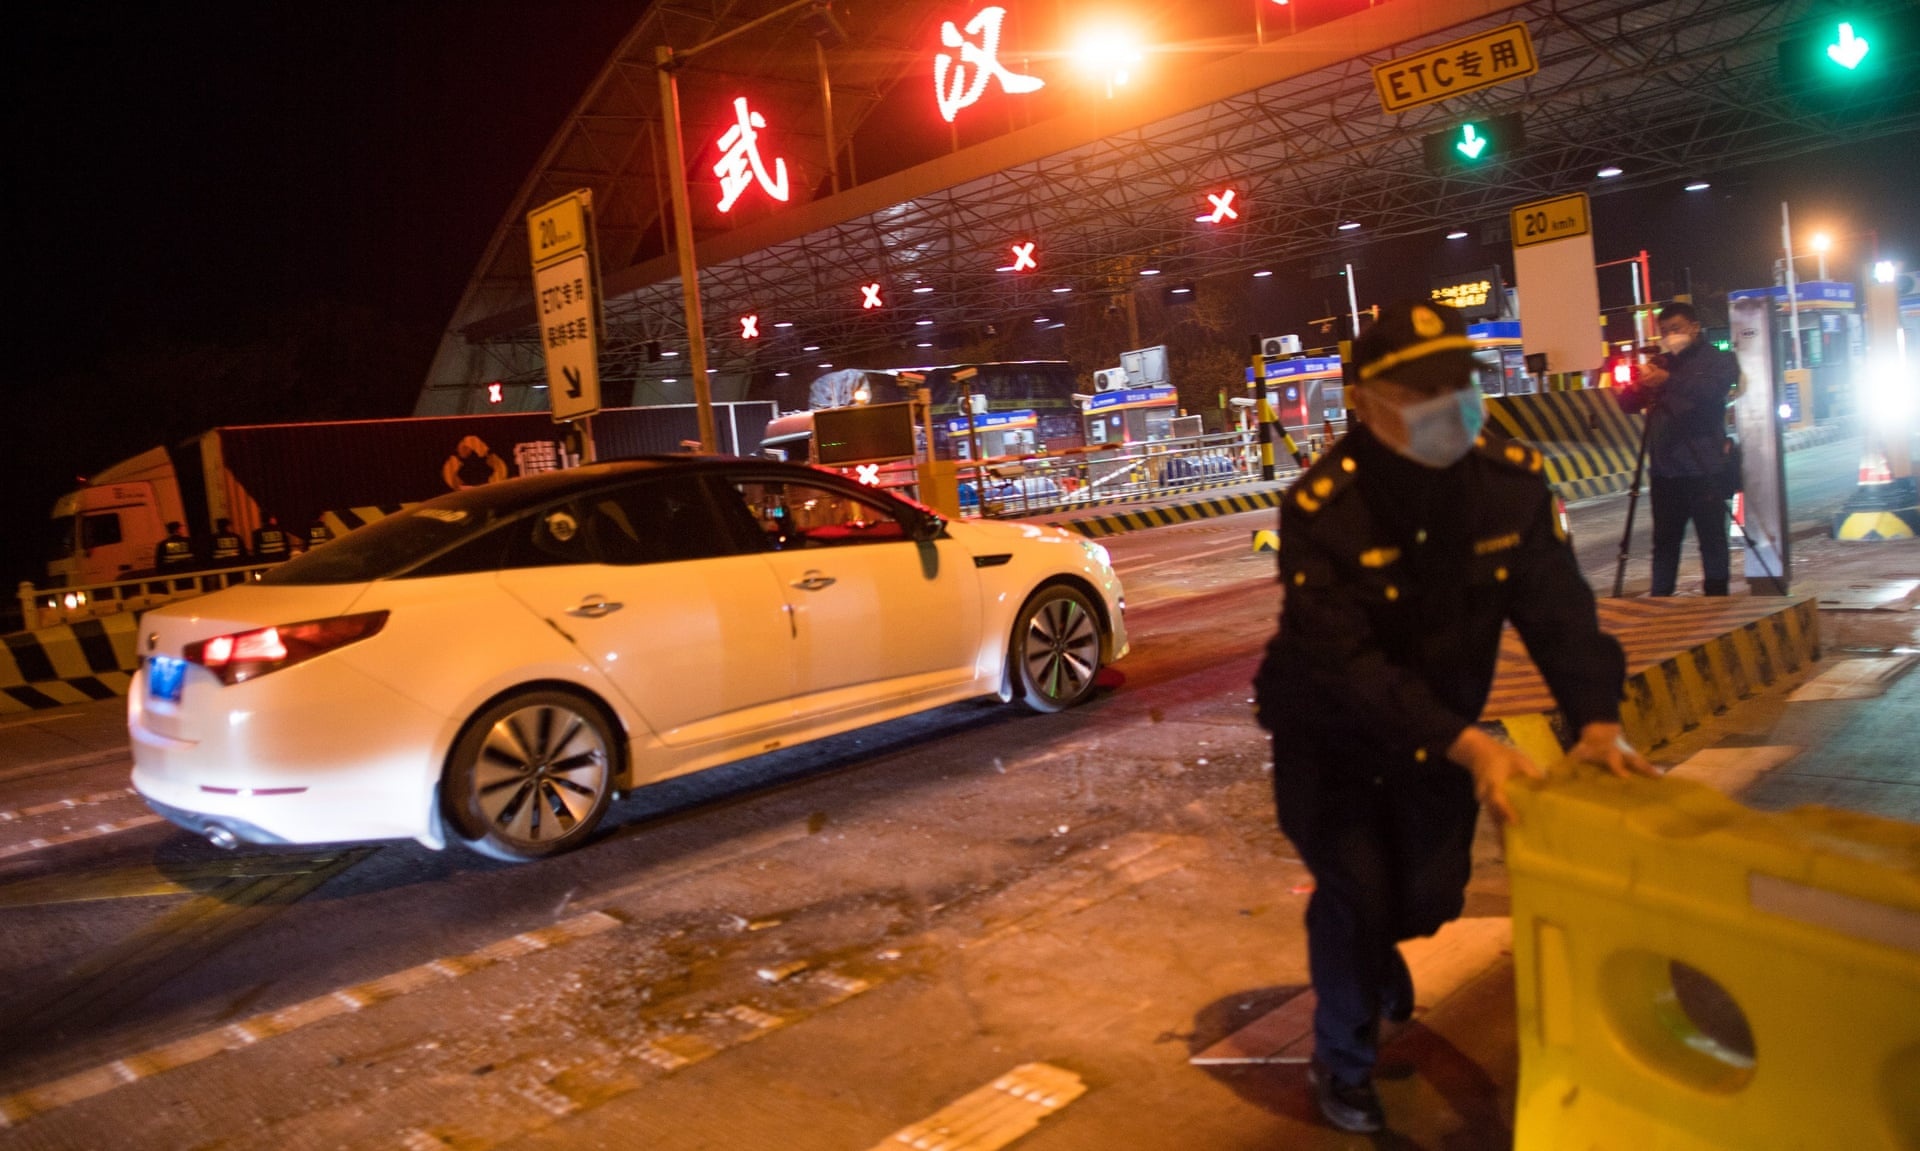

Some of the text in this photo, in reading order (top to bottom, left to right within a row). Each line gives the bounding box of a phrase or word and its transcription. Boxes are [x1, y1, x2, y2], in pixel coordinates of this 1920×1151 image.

[1388, 39, 1518, 101] ETC专用
[713, 6, 1045, 212] 武 汉
[540, 217, 556, 249] 20
[1525, 211, 1547, 236] 20
